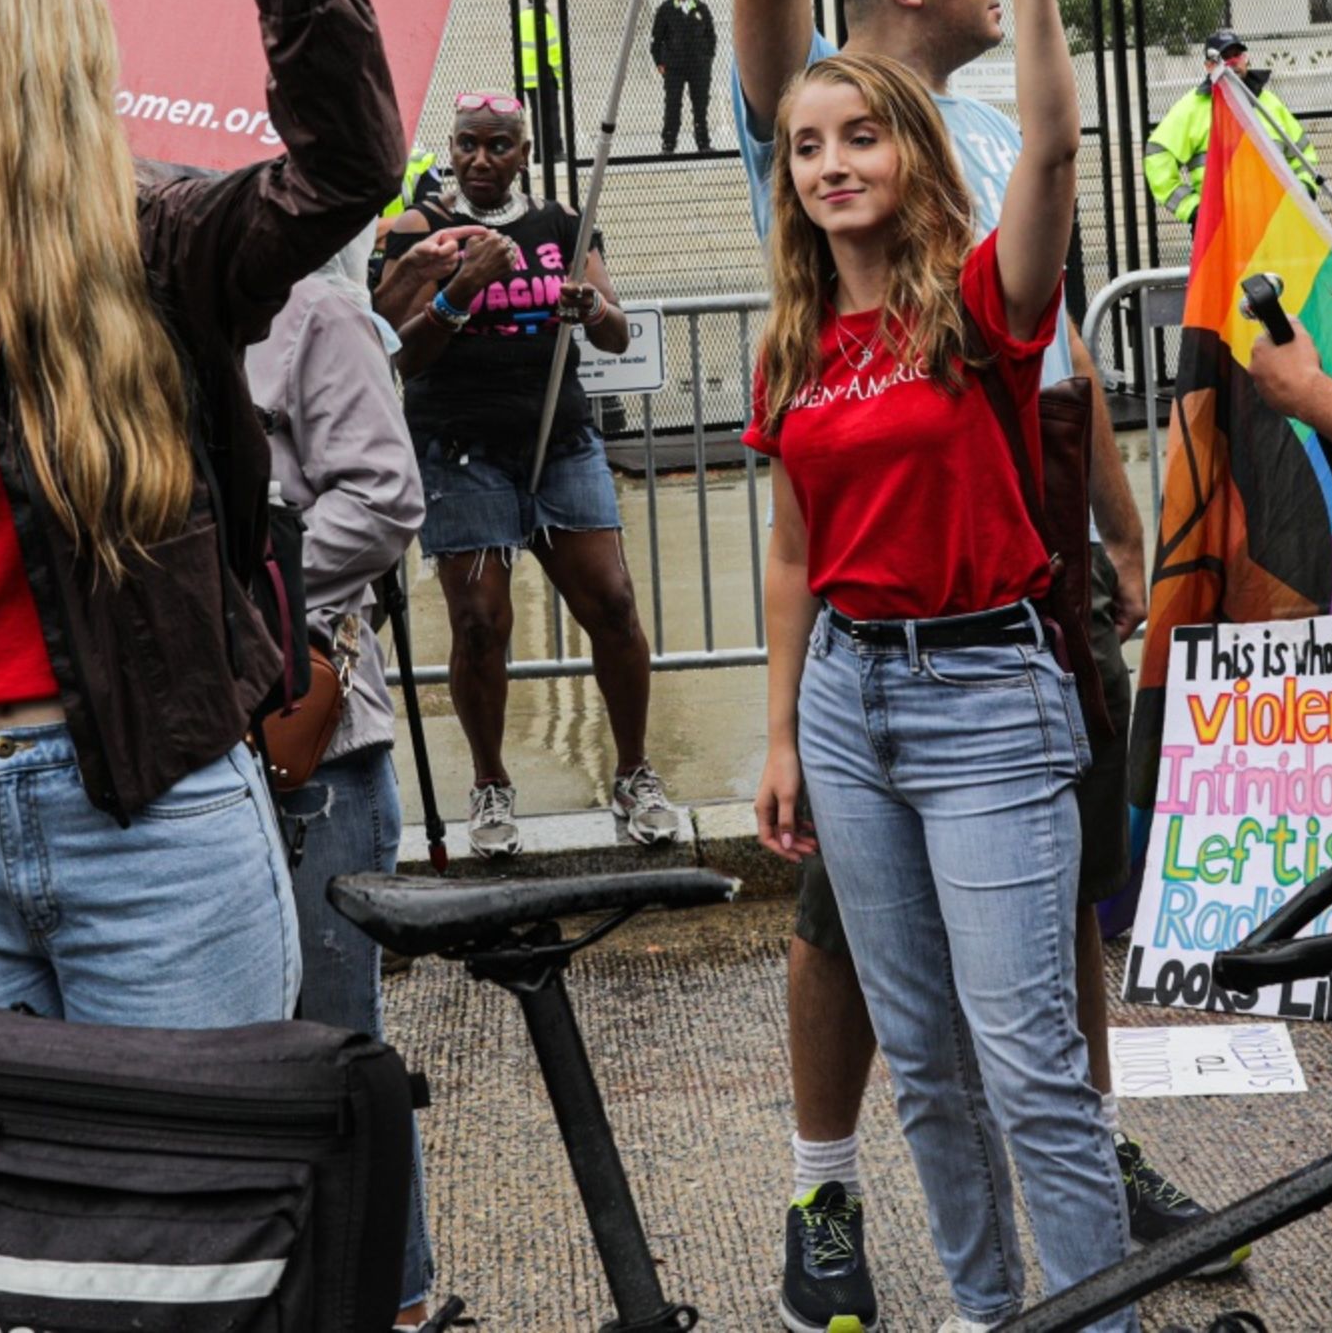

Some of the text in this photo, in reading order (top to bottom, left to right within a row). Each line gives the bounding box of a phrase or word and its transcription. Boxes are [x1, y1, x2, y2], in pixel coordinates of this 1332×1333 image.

[1173, 626, 1255, 680] This
[1261, 629, 1289, 679] is
[1195, 1055, 1230, 1075] TO
